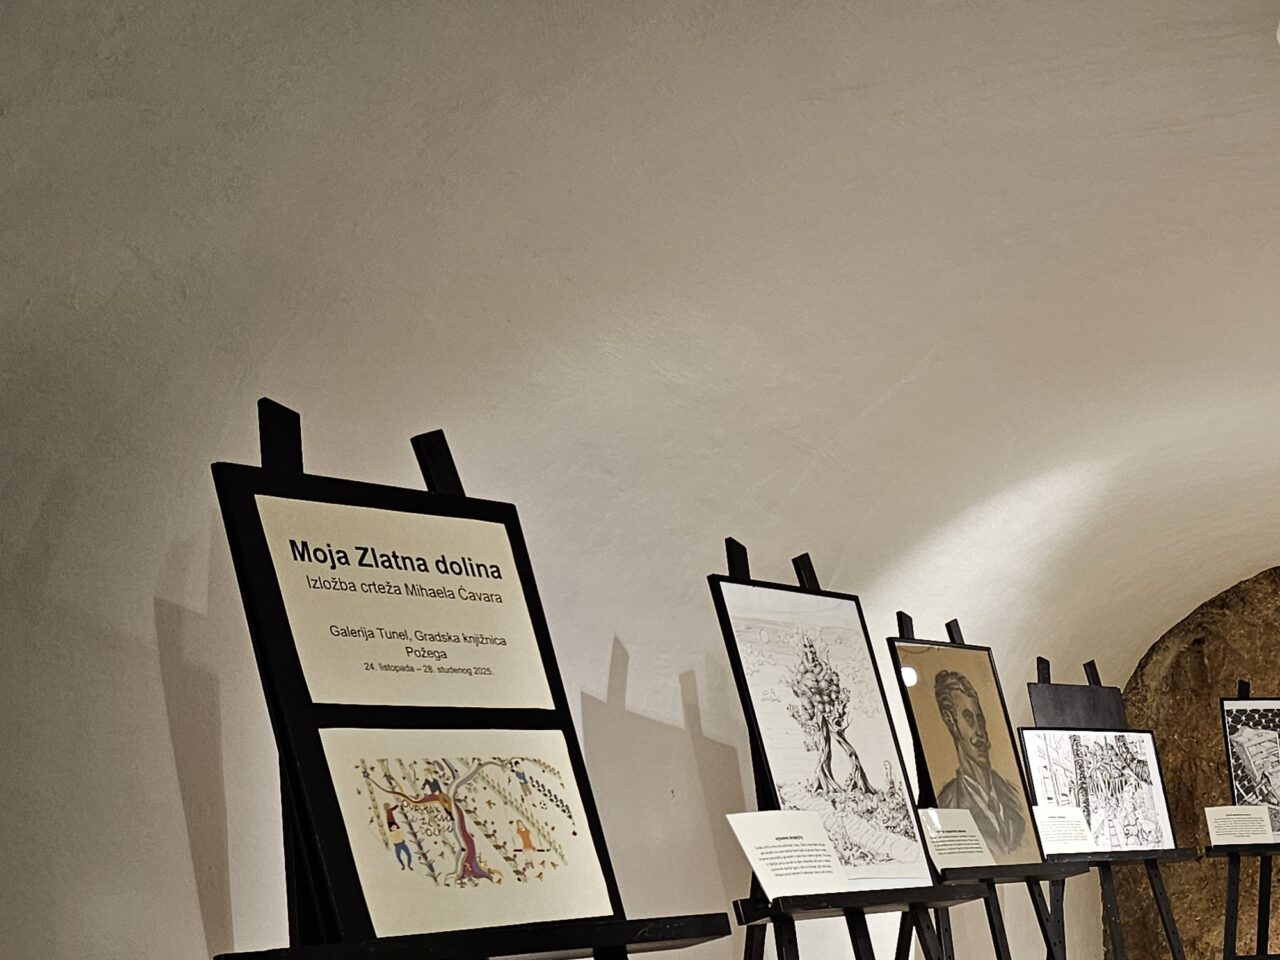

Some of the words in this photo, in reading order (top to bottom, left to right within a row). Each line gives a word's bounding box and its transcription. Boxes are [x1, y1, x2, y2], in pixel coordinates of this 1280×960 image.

[289, 539, 350, 570] Moja
[354, 546, 429, 573] Zlatna
[435, 555, 503, 580] dolina
[306, 575, 357, 592] Izložba
[361, 580, 402, 595] crteža
[404, 583, 455, 599] Mihaela
[329, 625, 375, 641] Galerija
[376, 627, 413, 642] Tunel,
[414, 630, 461, 643] Gradska
[462, 633, 507, 647] knjižnica
[405, 646, 448, 661] Požega
[379, 663, 415, 673] listopada
[437, 666, 473, 676] studenog
